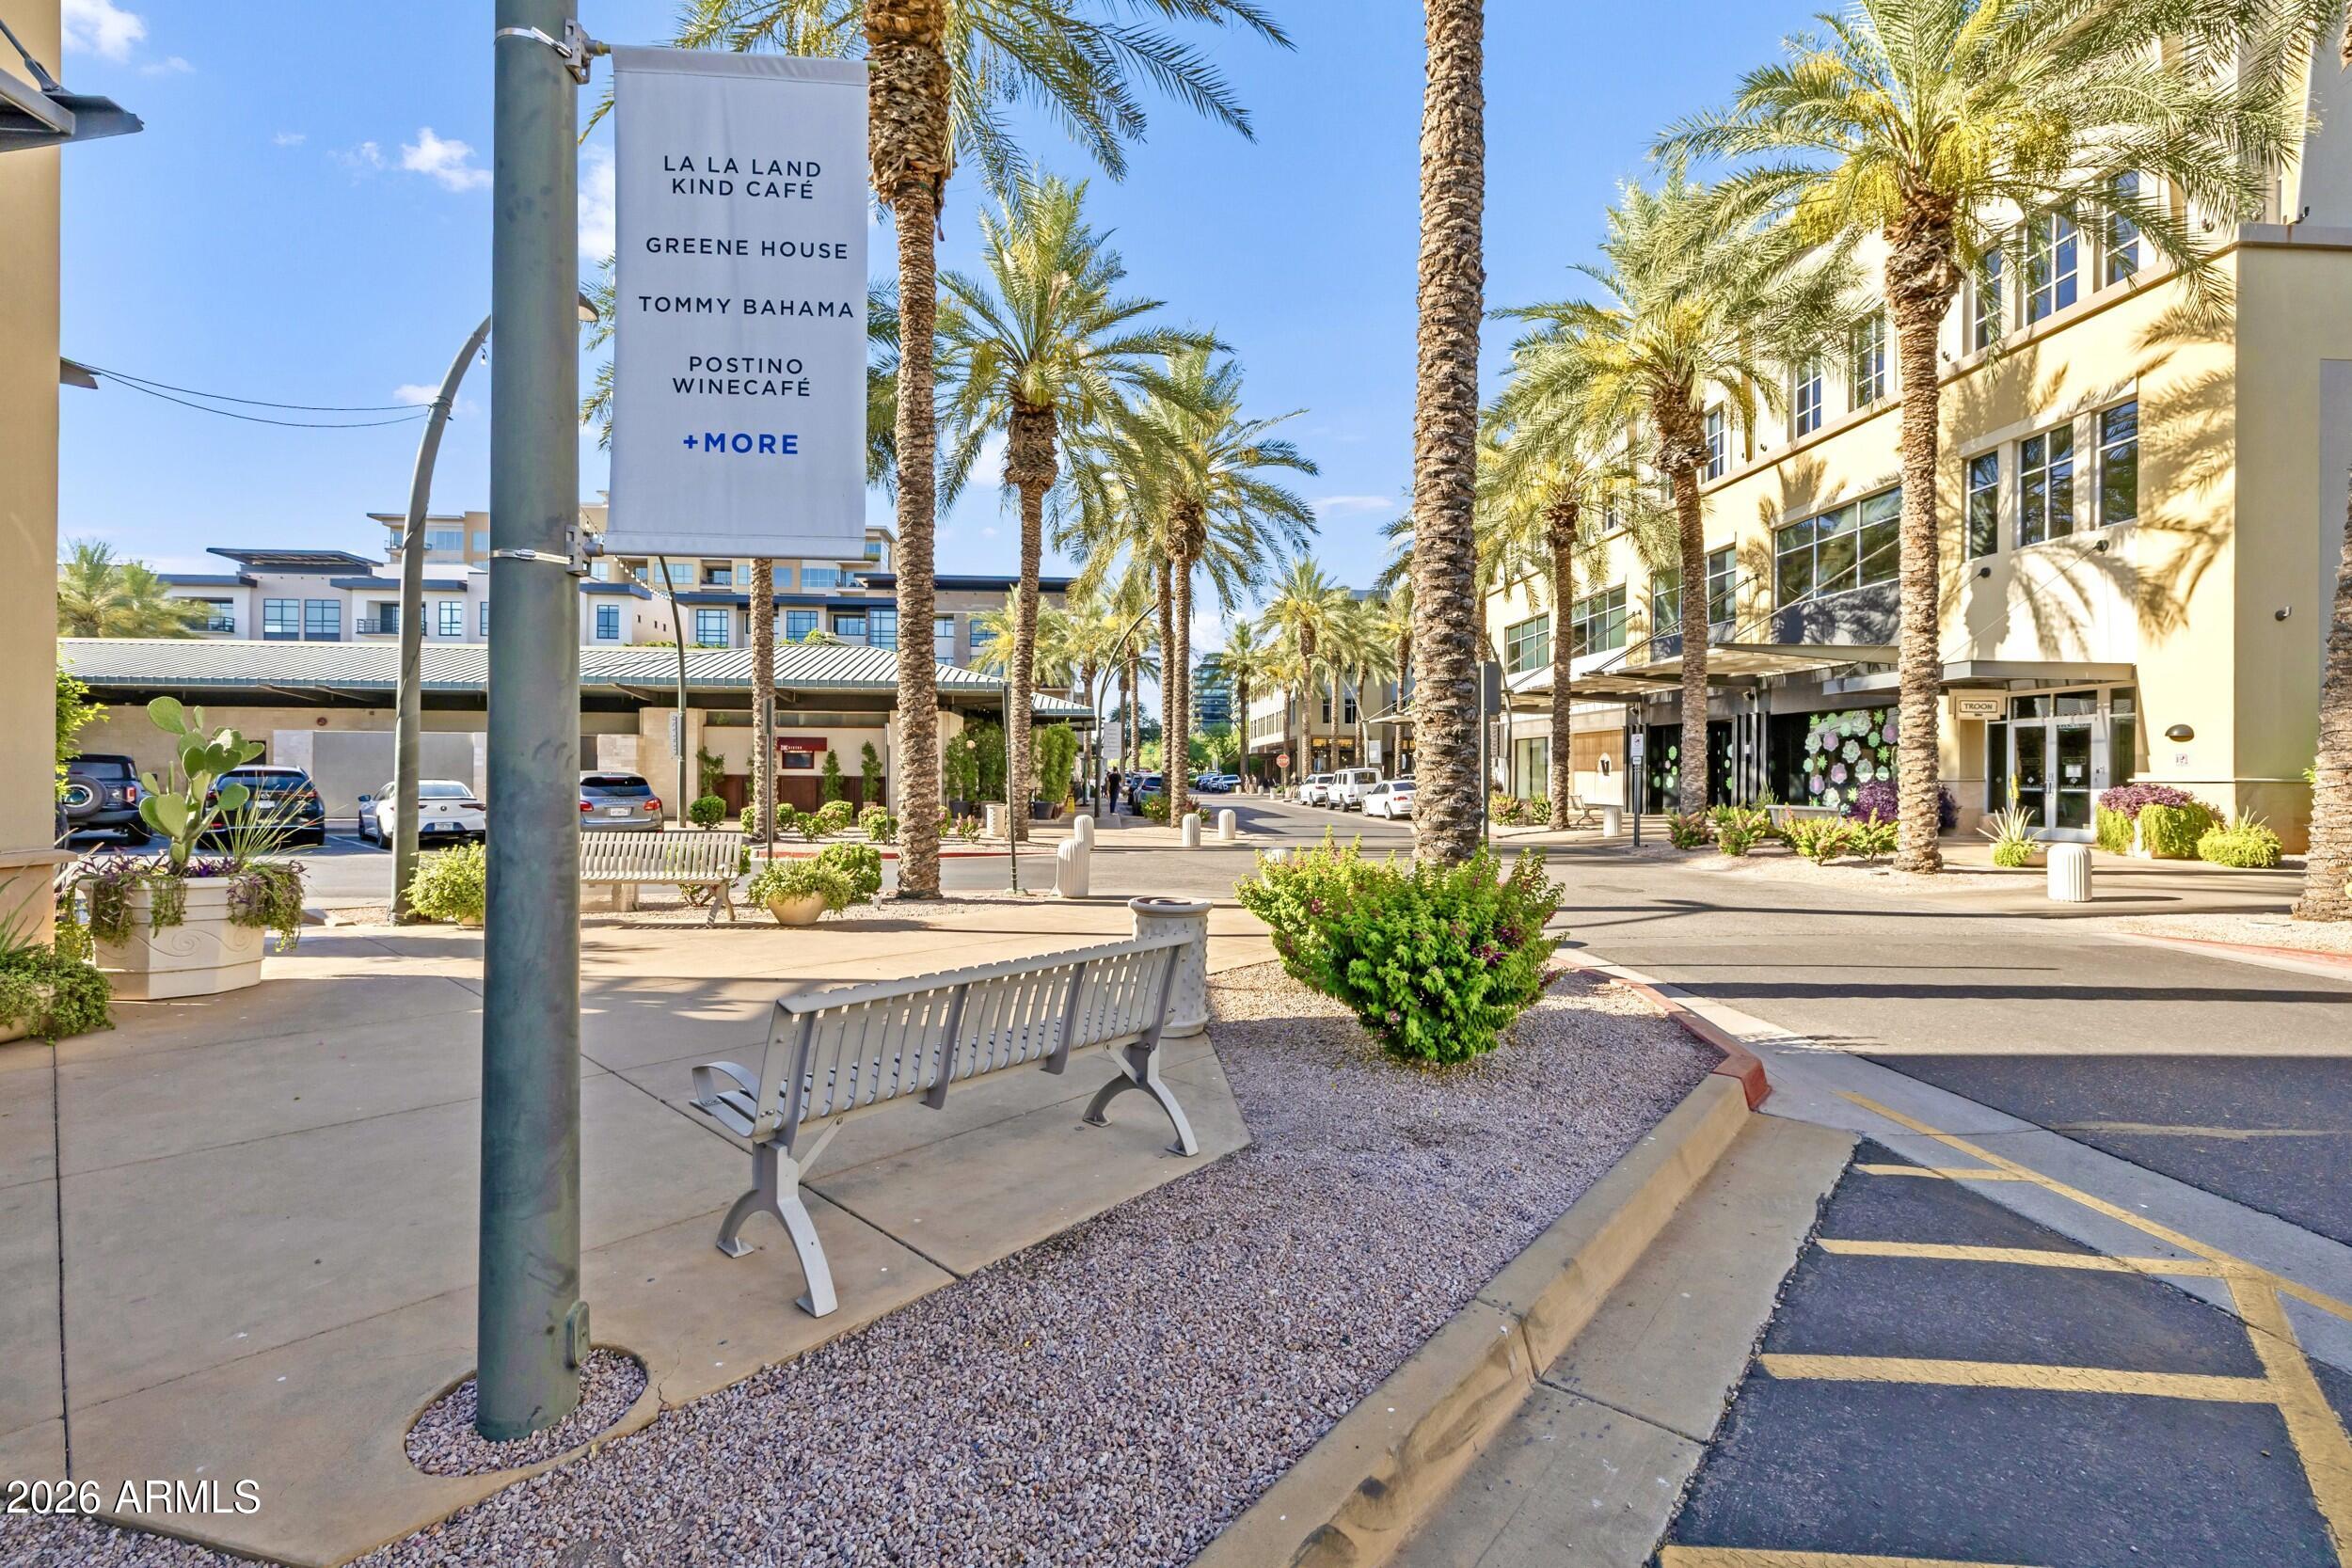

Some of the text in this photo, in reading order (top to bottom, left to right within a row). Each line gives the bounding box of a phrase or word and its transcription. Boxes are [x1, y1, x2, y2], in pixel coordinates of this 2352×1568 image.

[664, 155, 821, 178] LA LA LAND
[672, 178, 813, 199] KIND CAFÉ
[645, 237, 848, 260] GREENE HOUSE
[638, 295, 854, 318] TOMMY BAHAMA
[689, 356, 803, 374] POSTINO
[672, 377, 811, 397] WINECAFÉ
[683, 433, 798, 455] +MORE
